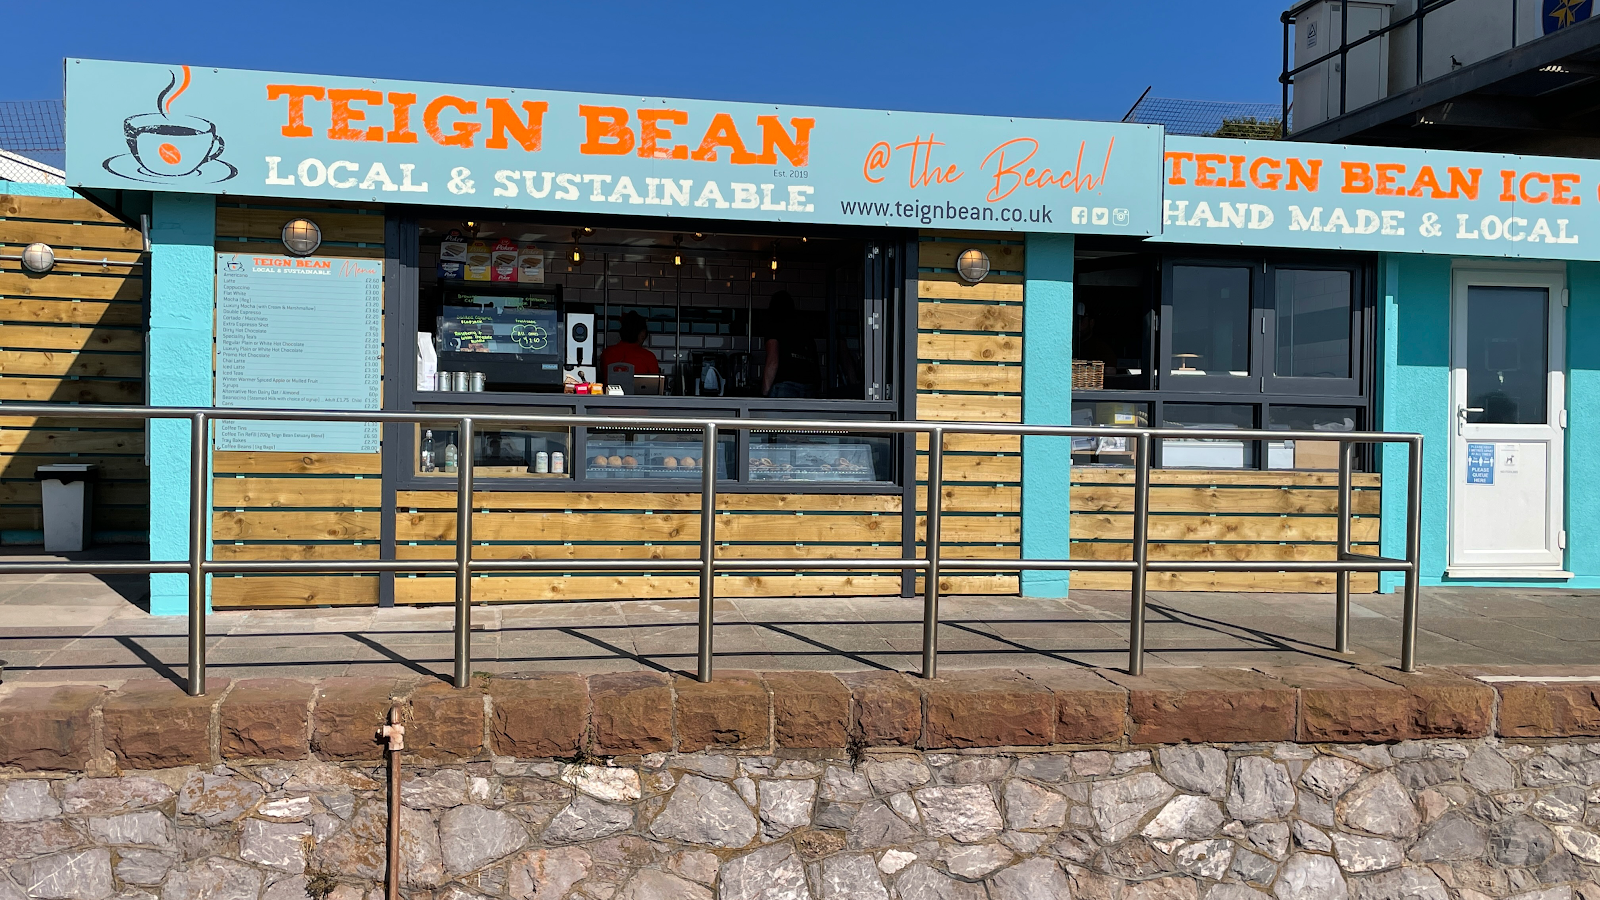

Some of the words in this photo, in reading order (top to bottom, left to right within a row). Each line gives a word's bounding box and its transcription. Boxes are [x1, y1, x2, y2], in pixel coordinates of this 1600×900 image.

[266, 84, 549, 153] TEIGN
[579, 104, 815, 168] BEAN
[265, 156, 429, 193] LOCAL
[447, 166, 476, 195] &
[494, 169, 815, 213] SUSTAINABLE
[773, 169, 788, 178] Est.
[789, 169, 809, 179] 2019
[863, 141, 892, 184] @
[895, 132, 965, 189] the
[980, 136, 1115, 203] Beach!
[1164, 151, 1323, 193] TEIGN
[1341, 160, 1483, 201] BEAN
[1500, 169, 1581, 206] ICE
[840, 199, 1053, 225] www.teignbean.co.uk
[1163, 199, 1275, 230] HAND
[1289, 204, 1405, 236] MADE
[1419, 211, 1443, 238] &
[1456, 213, 1579, 244] LOCAL
[253, 258, 292, 267] TEIGN
[296, 259, 331, 269] BEAN
[338, 260, 377, 278] Menu
